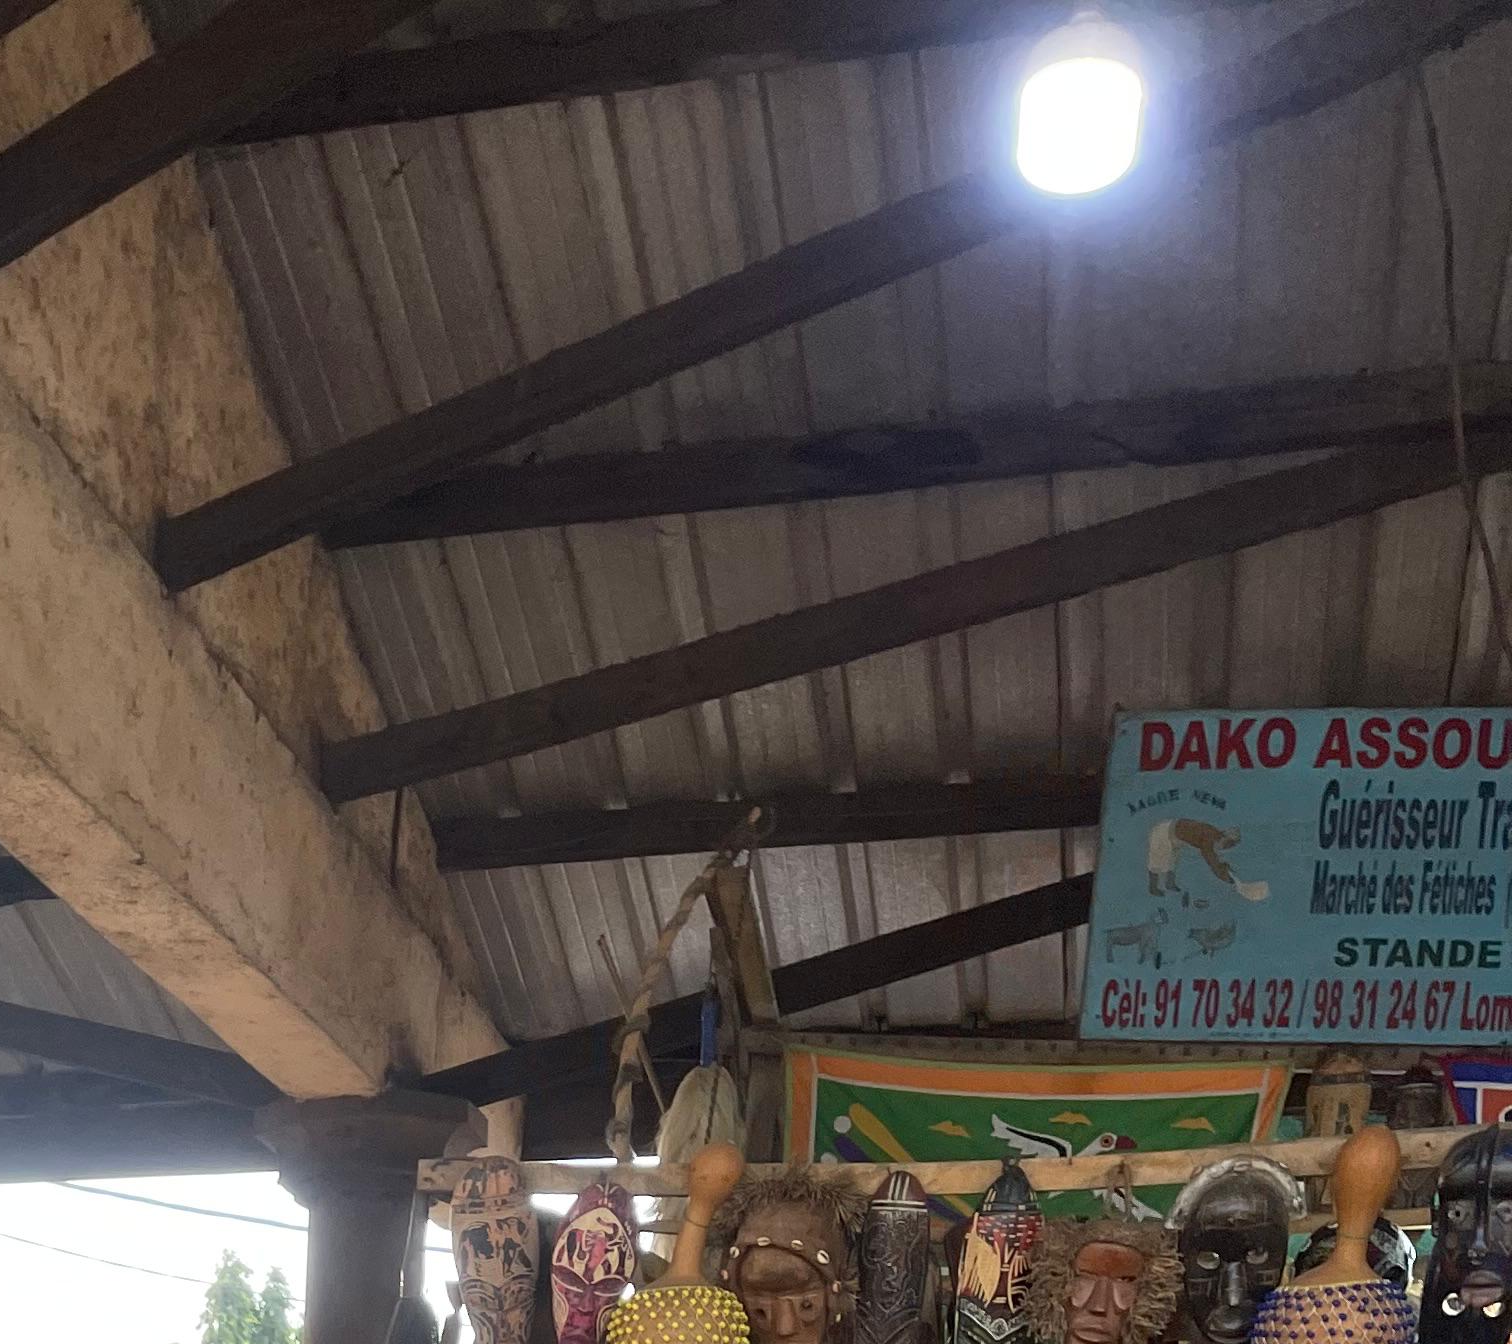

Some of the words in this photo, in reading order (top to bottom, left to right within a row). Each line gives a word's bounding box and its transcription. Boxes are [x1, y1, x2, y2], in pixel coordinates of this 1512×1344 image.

[1139, 717, 1297, 771] DAKO
[1319, 778, 1470, 849] Guérisseur
[1310, 860, 1377, 915] Marché
[1381, 860, 1414, 915] des
[1418, 860, 1497, 915] Fétiches
[1334, 936, 1503, 969] STANDE
[1154, 977, 1183, 1028] 91
[1191, 977, 1220, 1029] 70
[1226, 978, 1256, 1028] 34
[1262, 978, 1294, 1028] 32
[1313, 978, 1344, 1029] 98
[1349, 979, 1380, 1029] 31
[1386, 979, 1418, 1030] 24
[1424, 980, 1457, 1031] 67
